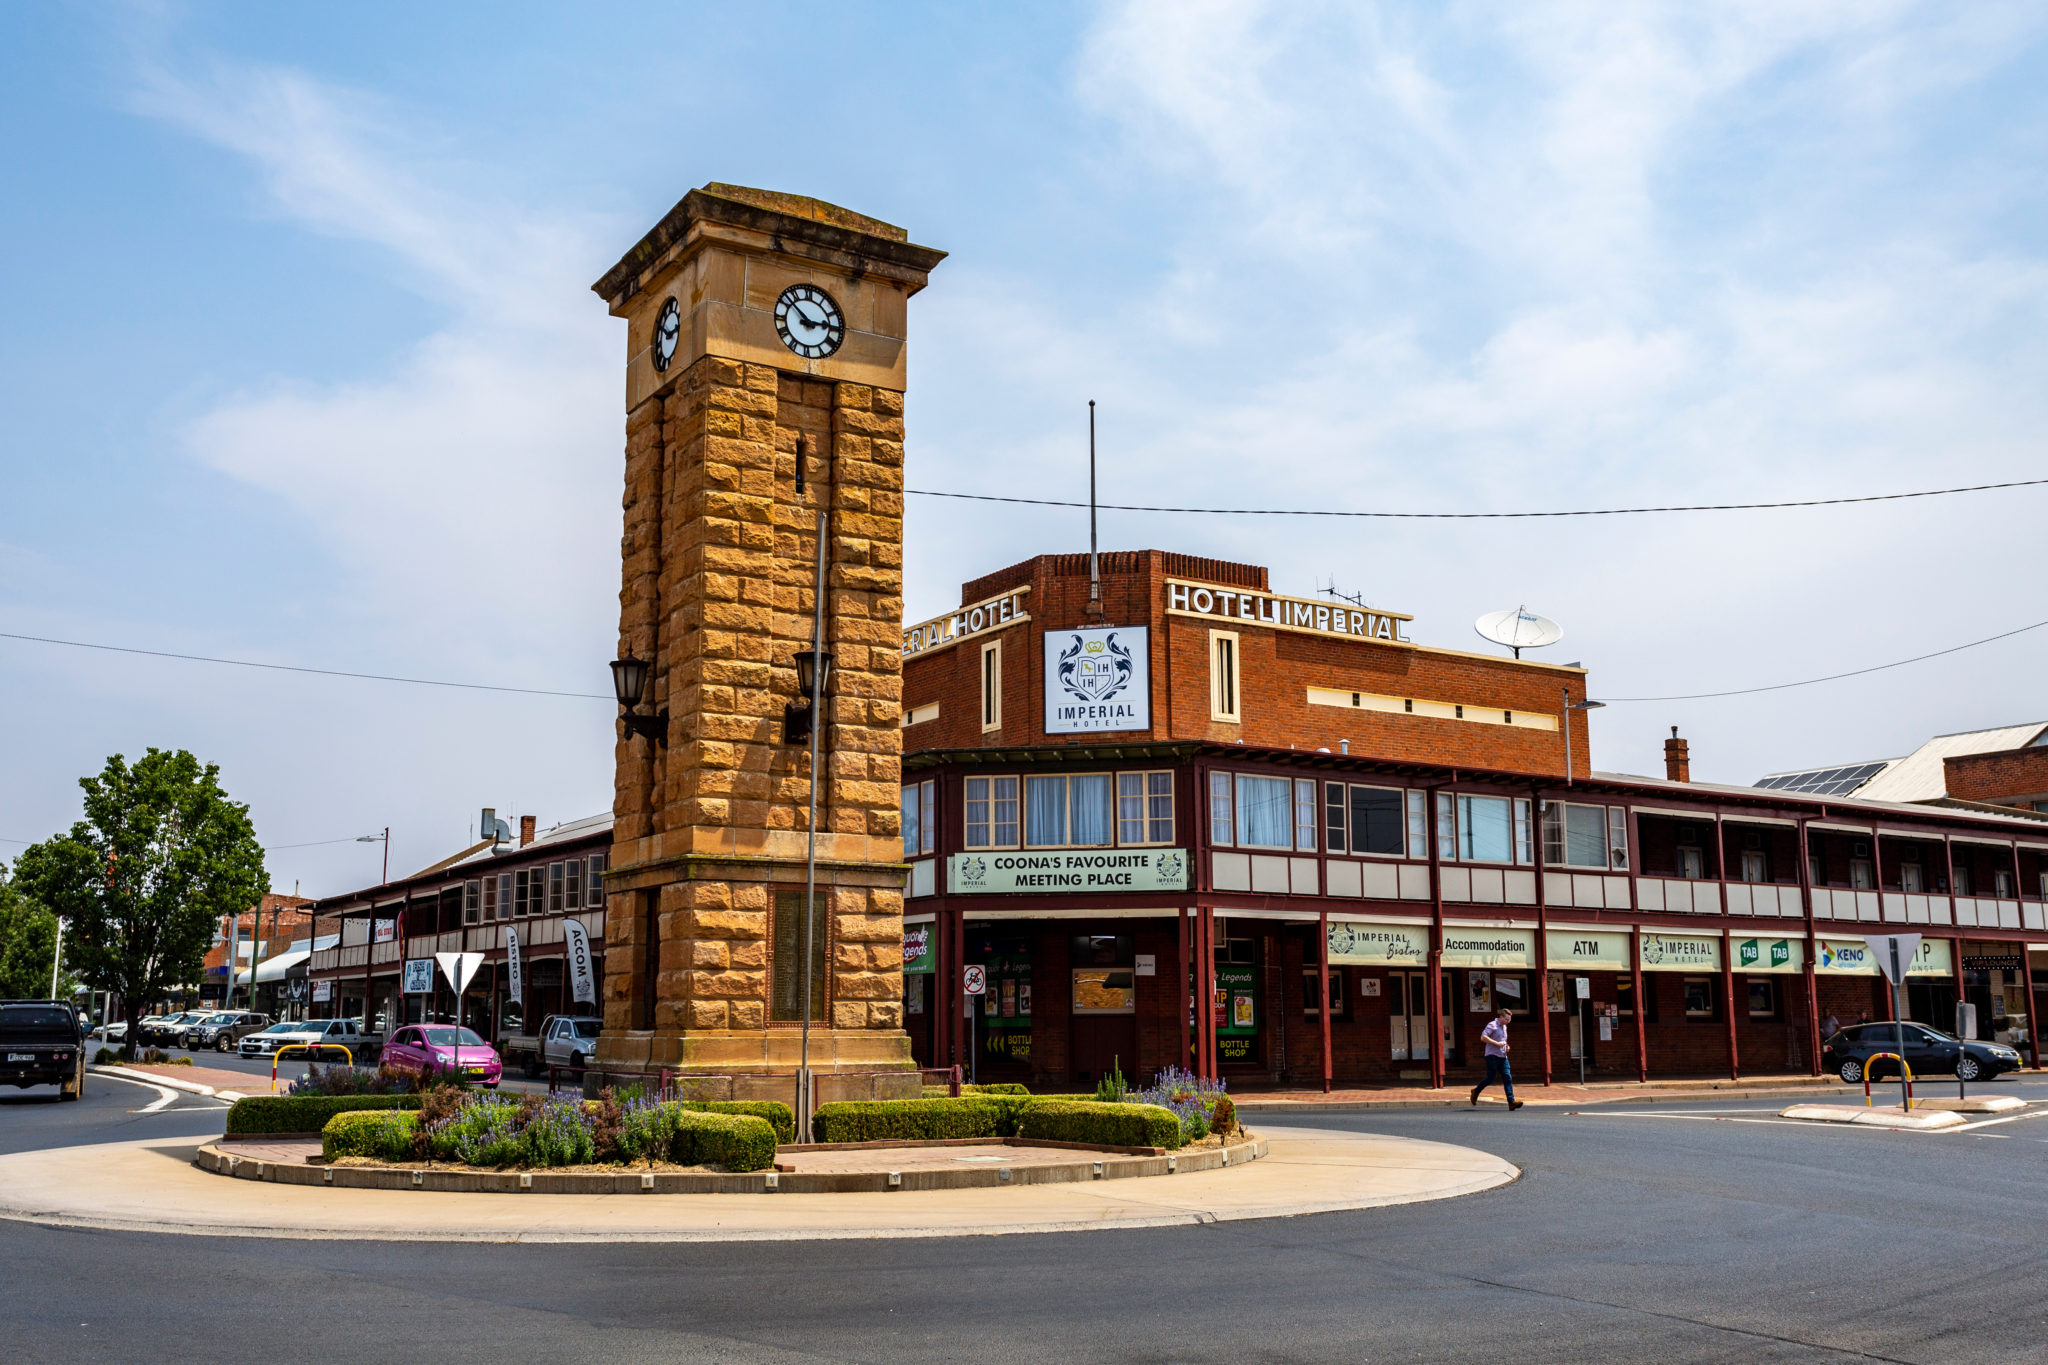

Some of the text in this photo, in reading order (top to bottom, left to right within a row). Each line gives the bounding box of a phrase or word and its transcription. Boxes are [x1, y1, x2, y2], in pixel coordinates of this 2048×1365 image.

[1170, 584, 1411, 642] HOTEL IMPERIAL
[902, 594, 1024, 656] ERIAL HOTEL
[1058, 704, 1135, 720] IMPERIAL
[1073, 719, 1120, 728] HOTEL
[994, 855, 1149, 870] COONA'S FAVOURITE
[1015, 873, 1132, 886] MEETING PLACE
[903, 932, 921, 946] quor
[1357, 932, 1407, 943] IMPERIAL
[903, 943, 928, 960] gends
[1386, 940, 1423, 960] Bistro
[1445, 938, 1525, 952] Accommodation
[1573, 940, 1599, 955] ATM
[1665, 942, 1712, 955] IMPERIAL
[510, 935, 519, 980] BISTRO
[572, 929, 587, 977] ACCOM
[1741, 946, 1757, 958] TAB
[1772, 947, 1788, 959] TAB
[1836, 948, 1864, 961] KENO
[1915, 943, 1931, 962] IP
[1221, 972, 1252, 983] Legends
[1216, 992, 1227, 1003] IP
[1220, 1040, 1250, 1048] BOTTLE
[1011, 1047, 1030, 1055] SHOP
[1224, 1049, 1246, 1057] SHOP
